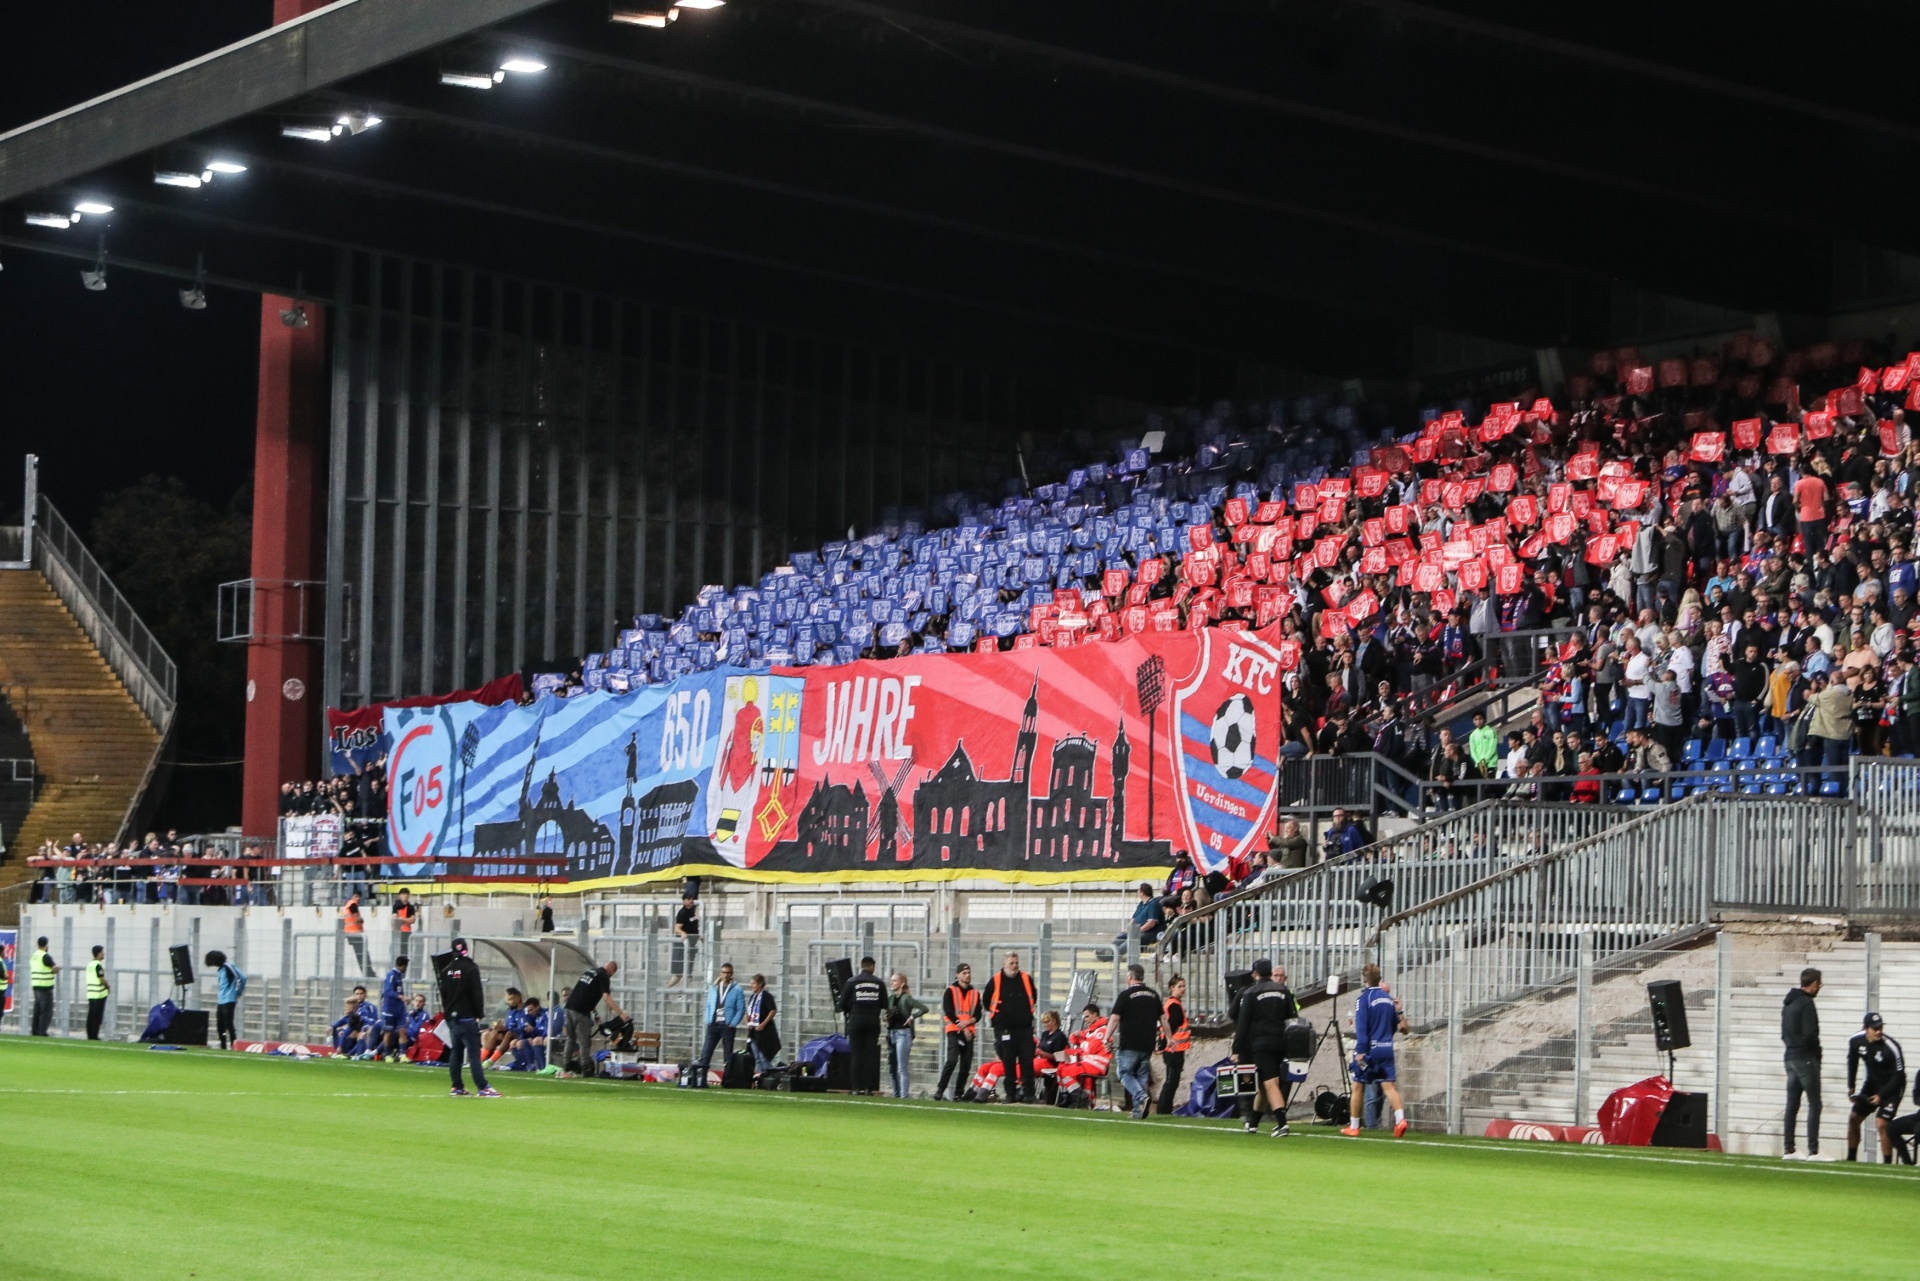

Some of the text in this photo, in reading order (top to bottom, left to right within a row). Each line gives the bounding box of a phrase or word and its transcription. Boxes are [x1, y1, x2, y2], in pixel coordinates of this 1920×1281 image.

[1221, 642, 1278, 695] KFC
[334, 725, 378, 752] Los
[661, 675, 922, 773] 650 JAHRE
[1196, 784, 1246, 818] Uerdingen
[1210, 832, 1223, 850] 05
